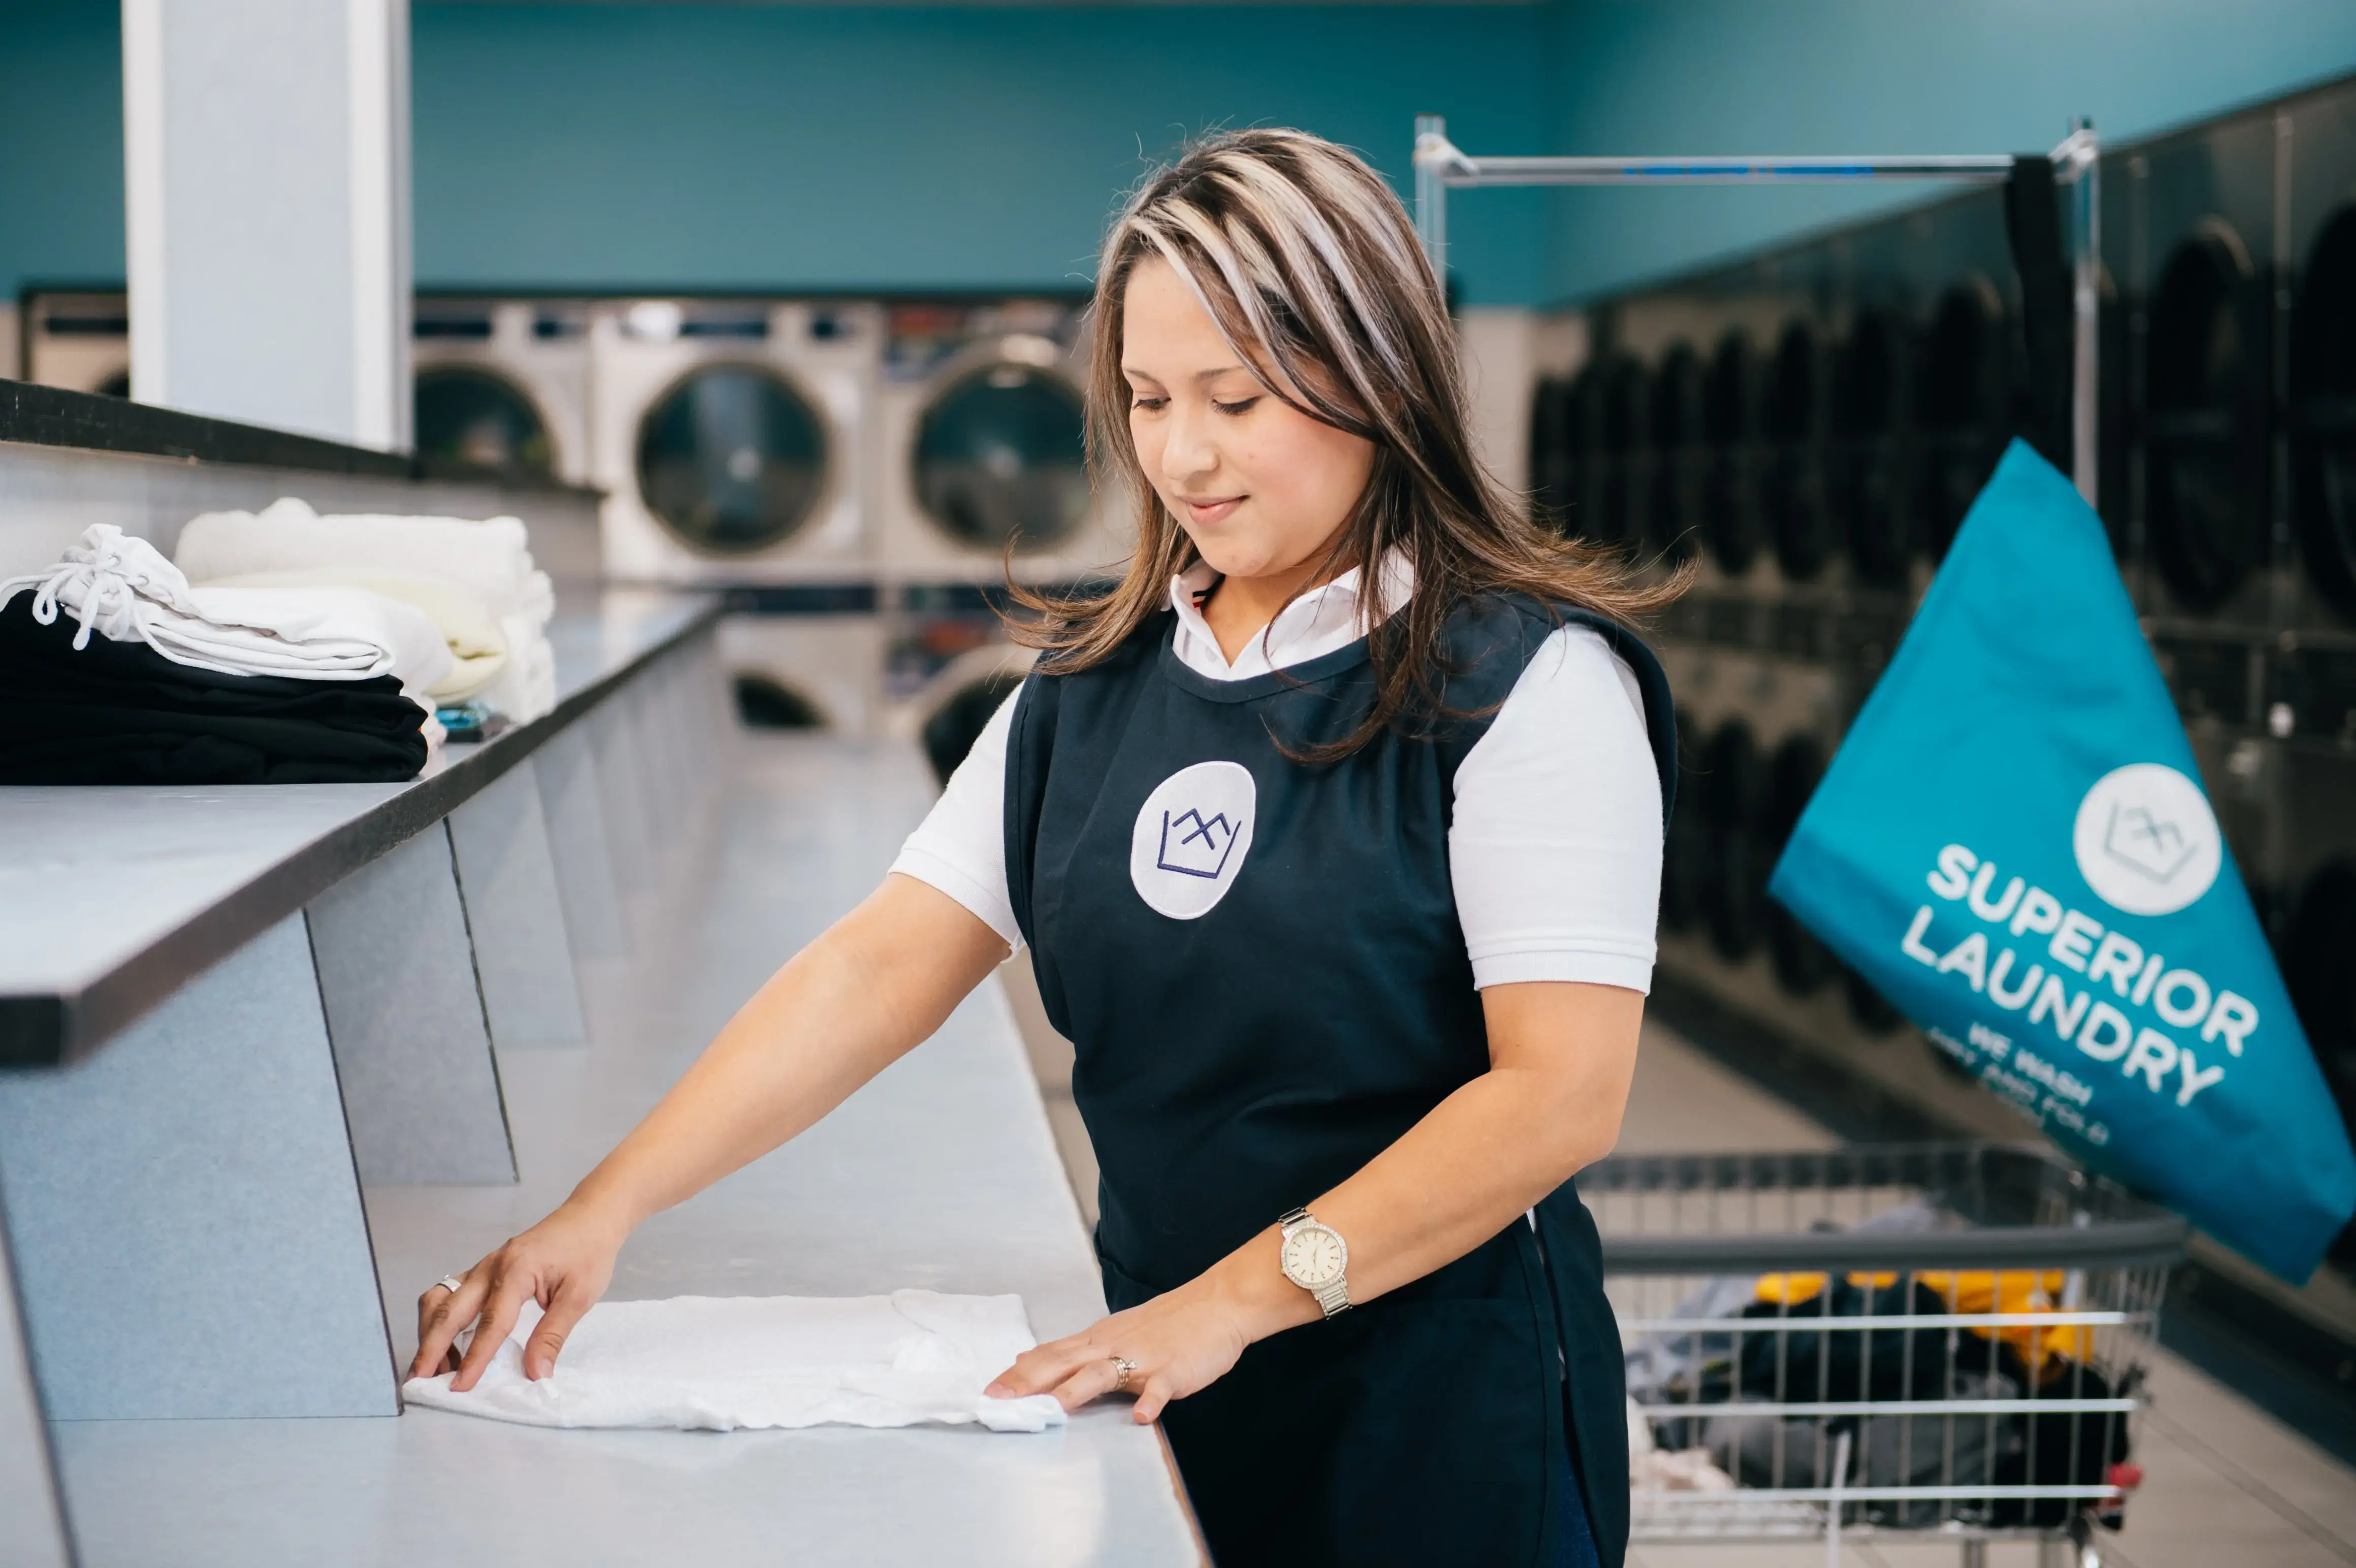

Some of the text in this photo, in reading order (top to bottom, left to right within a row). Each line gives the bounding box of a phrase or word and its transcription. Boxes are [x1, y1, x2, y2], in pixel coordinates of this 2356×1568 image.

[1902, 905, 2224, 1106] LAUNDRY
[1927, 844, 2258, 1057] SUPERIOR
[1968, 1023, 2011, 1060] WE
[2016, 1049, 2093, 1106] WASH
